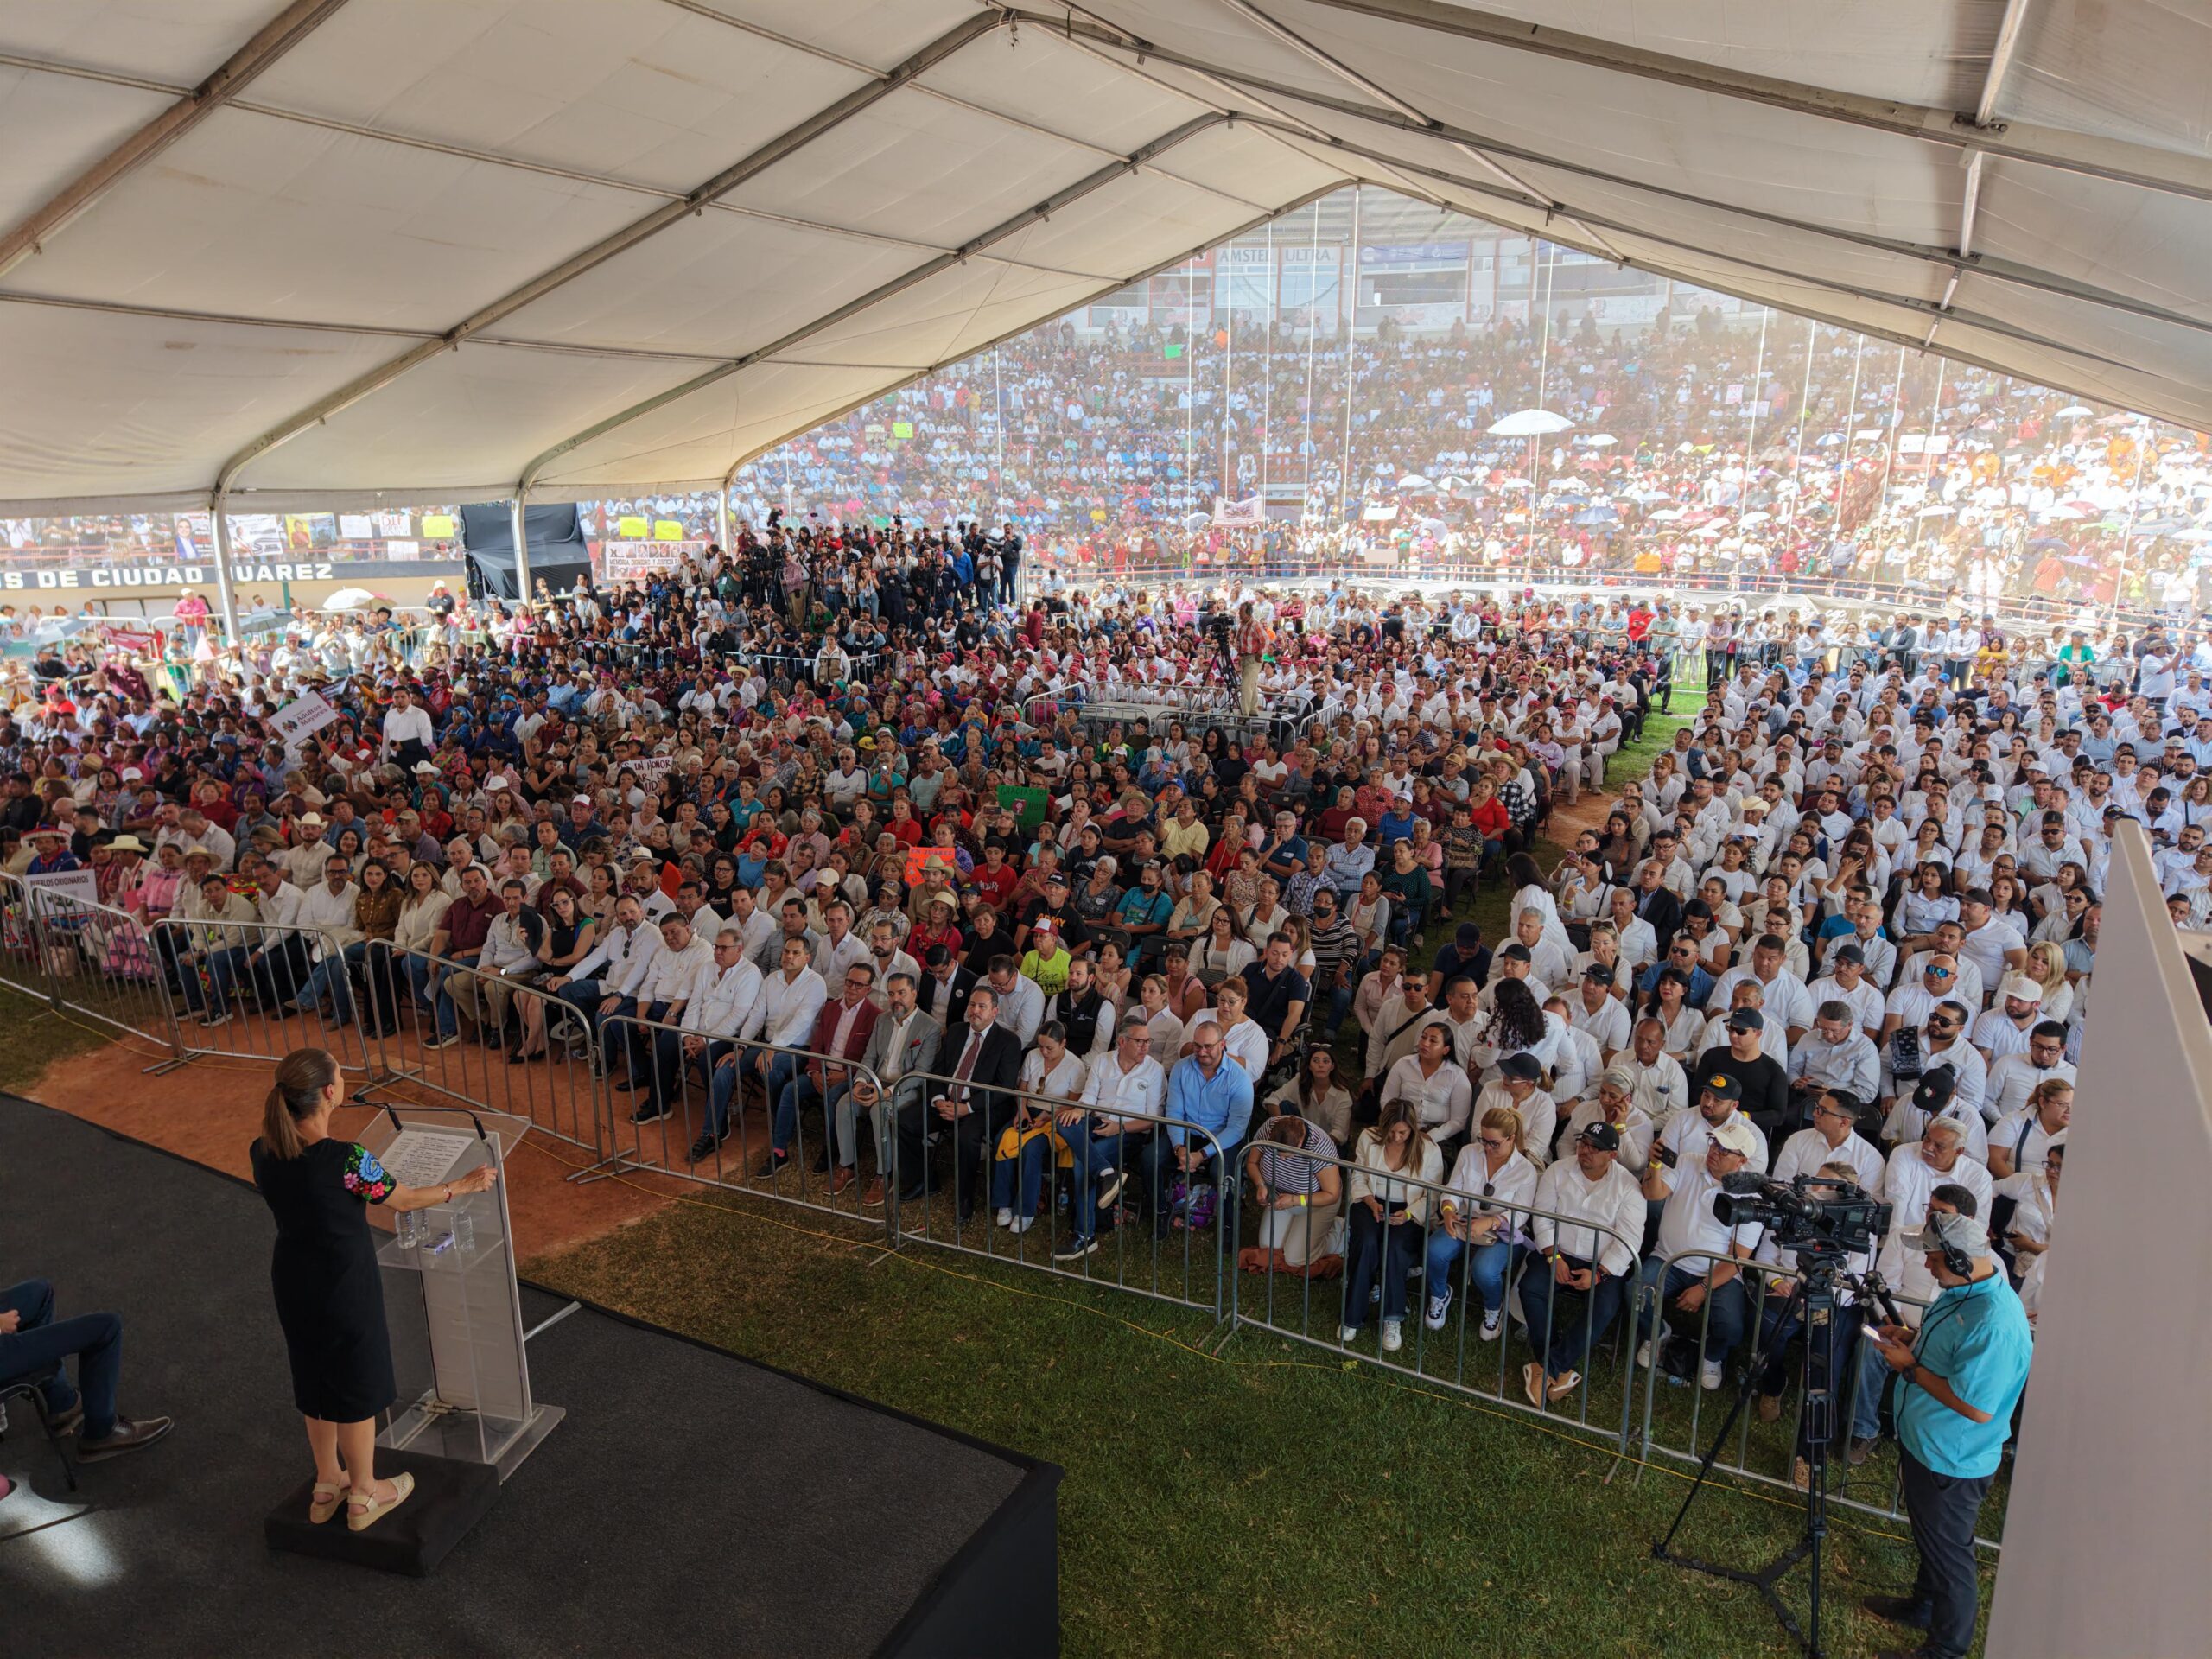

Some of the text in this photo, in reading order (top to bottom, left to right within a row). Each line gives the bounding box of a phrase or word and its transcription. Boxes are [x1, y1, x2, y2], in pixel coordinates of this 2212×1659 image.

[0, 571, 24, 588] S
[37, 570, 79, 588] DE
[92, 567, 203, 587] CIUDAD
[297, 704, 322, 721] Adultos
[301, 709, 328, 727] Mayores
[1001, 785, 1033, 796] GRACIAS
[30, 875, 89, 887] PUEBLOS ORIGINARIOS
